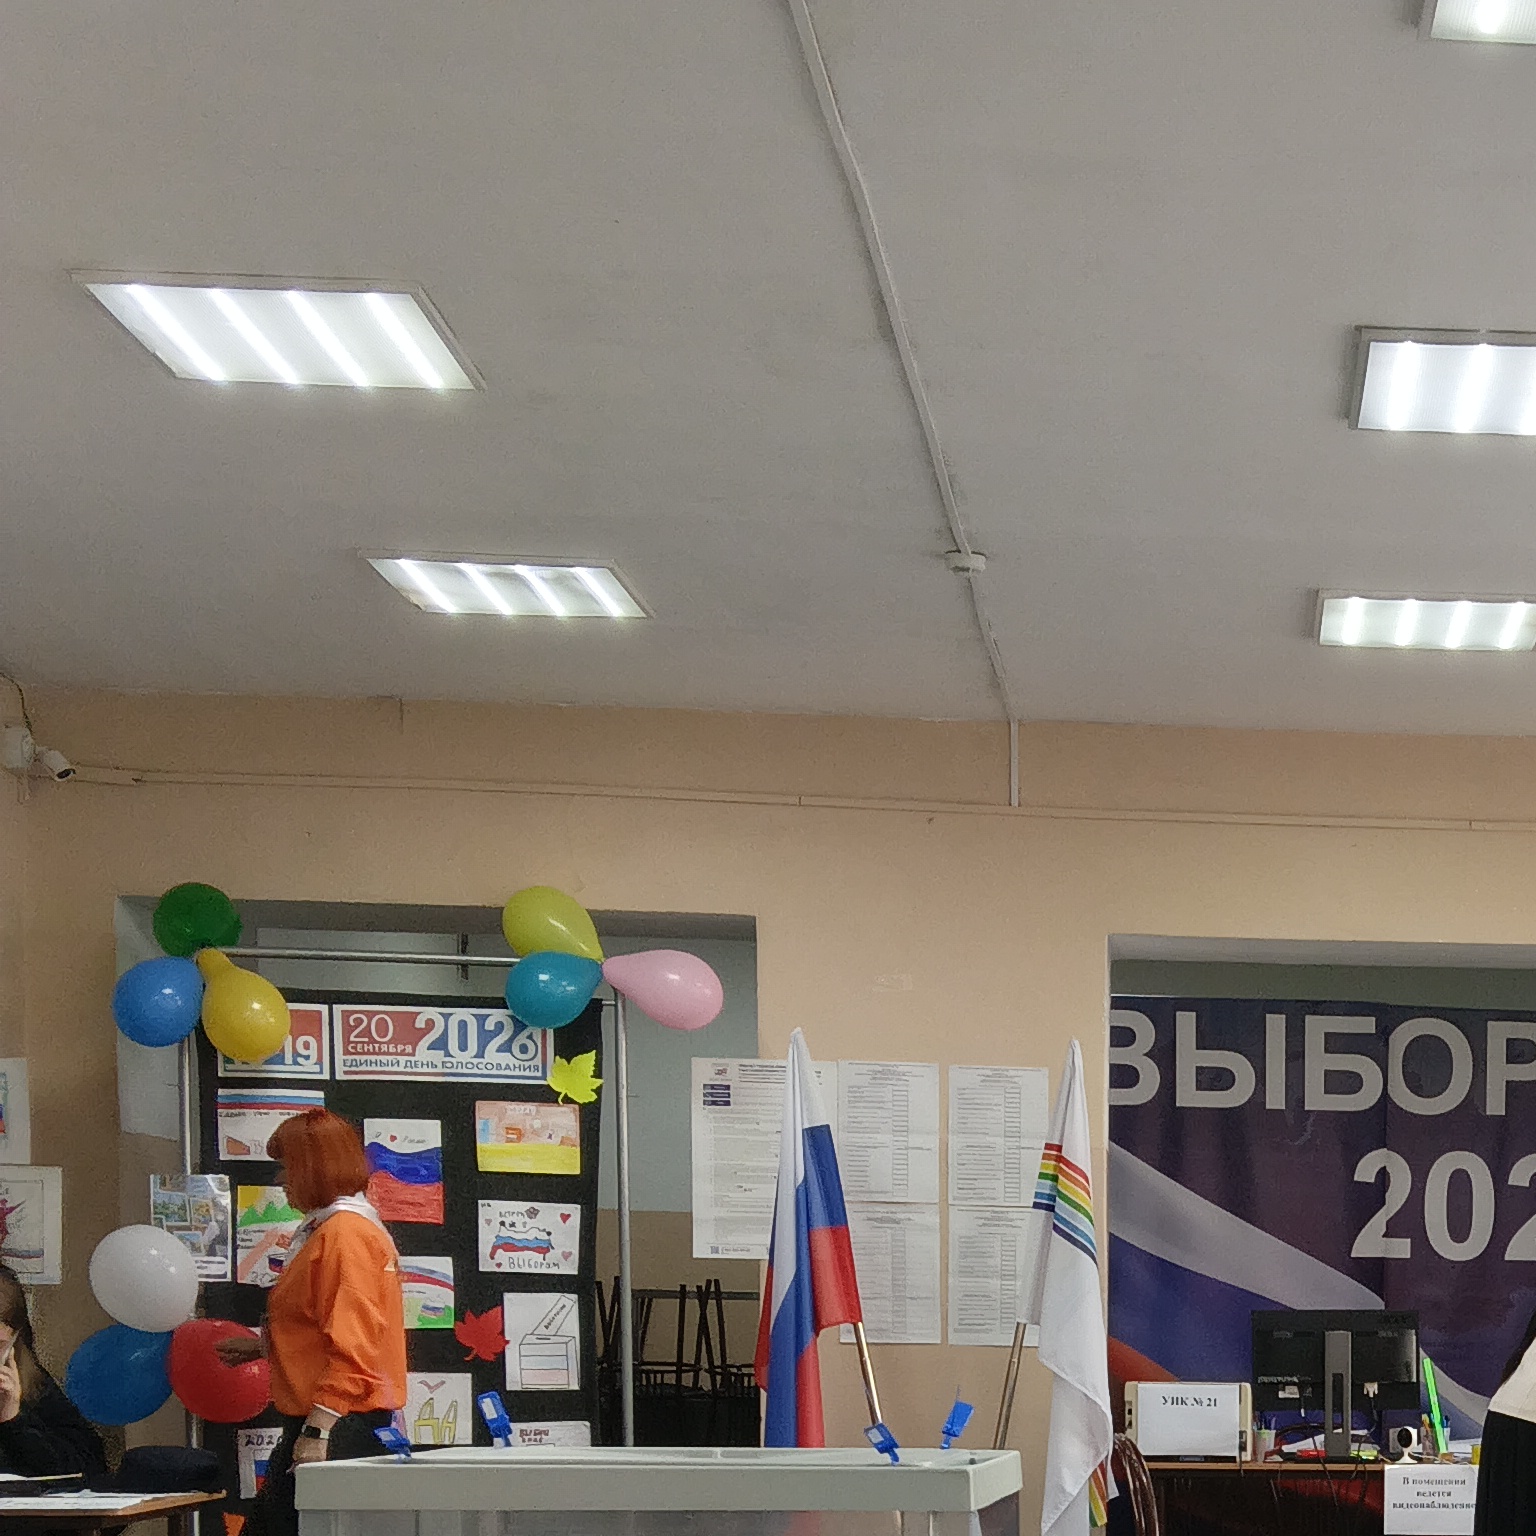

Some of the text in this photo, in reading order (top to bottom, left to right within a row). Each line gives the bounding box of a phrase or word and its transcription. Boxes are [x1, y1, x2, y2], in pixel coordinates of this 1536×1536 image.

[349, 1014, 395, 1042] 20
[347, 1043, 413, 1054] СЕНТЯБРЯ
[343, 1058, 541, 1073] ЕДИНЫЙ ДЕНЬ ГОЛОСОВАНИЯ
[1161, 1395, 1218, 1408] УИК № 21
[1412, 1478, 1467, 1486] помещении
